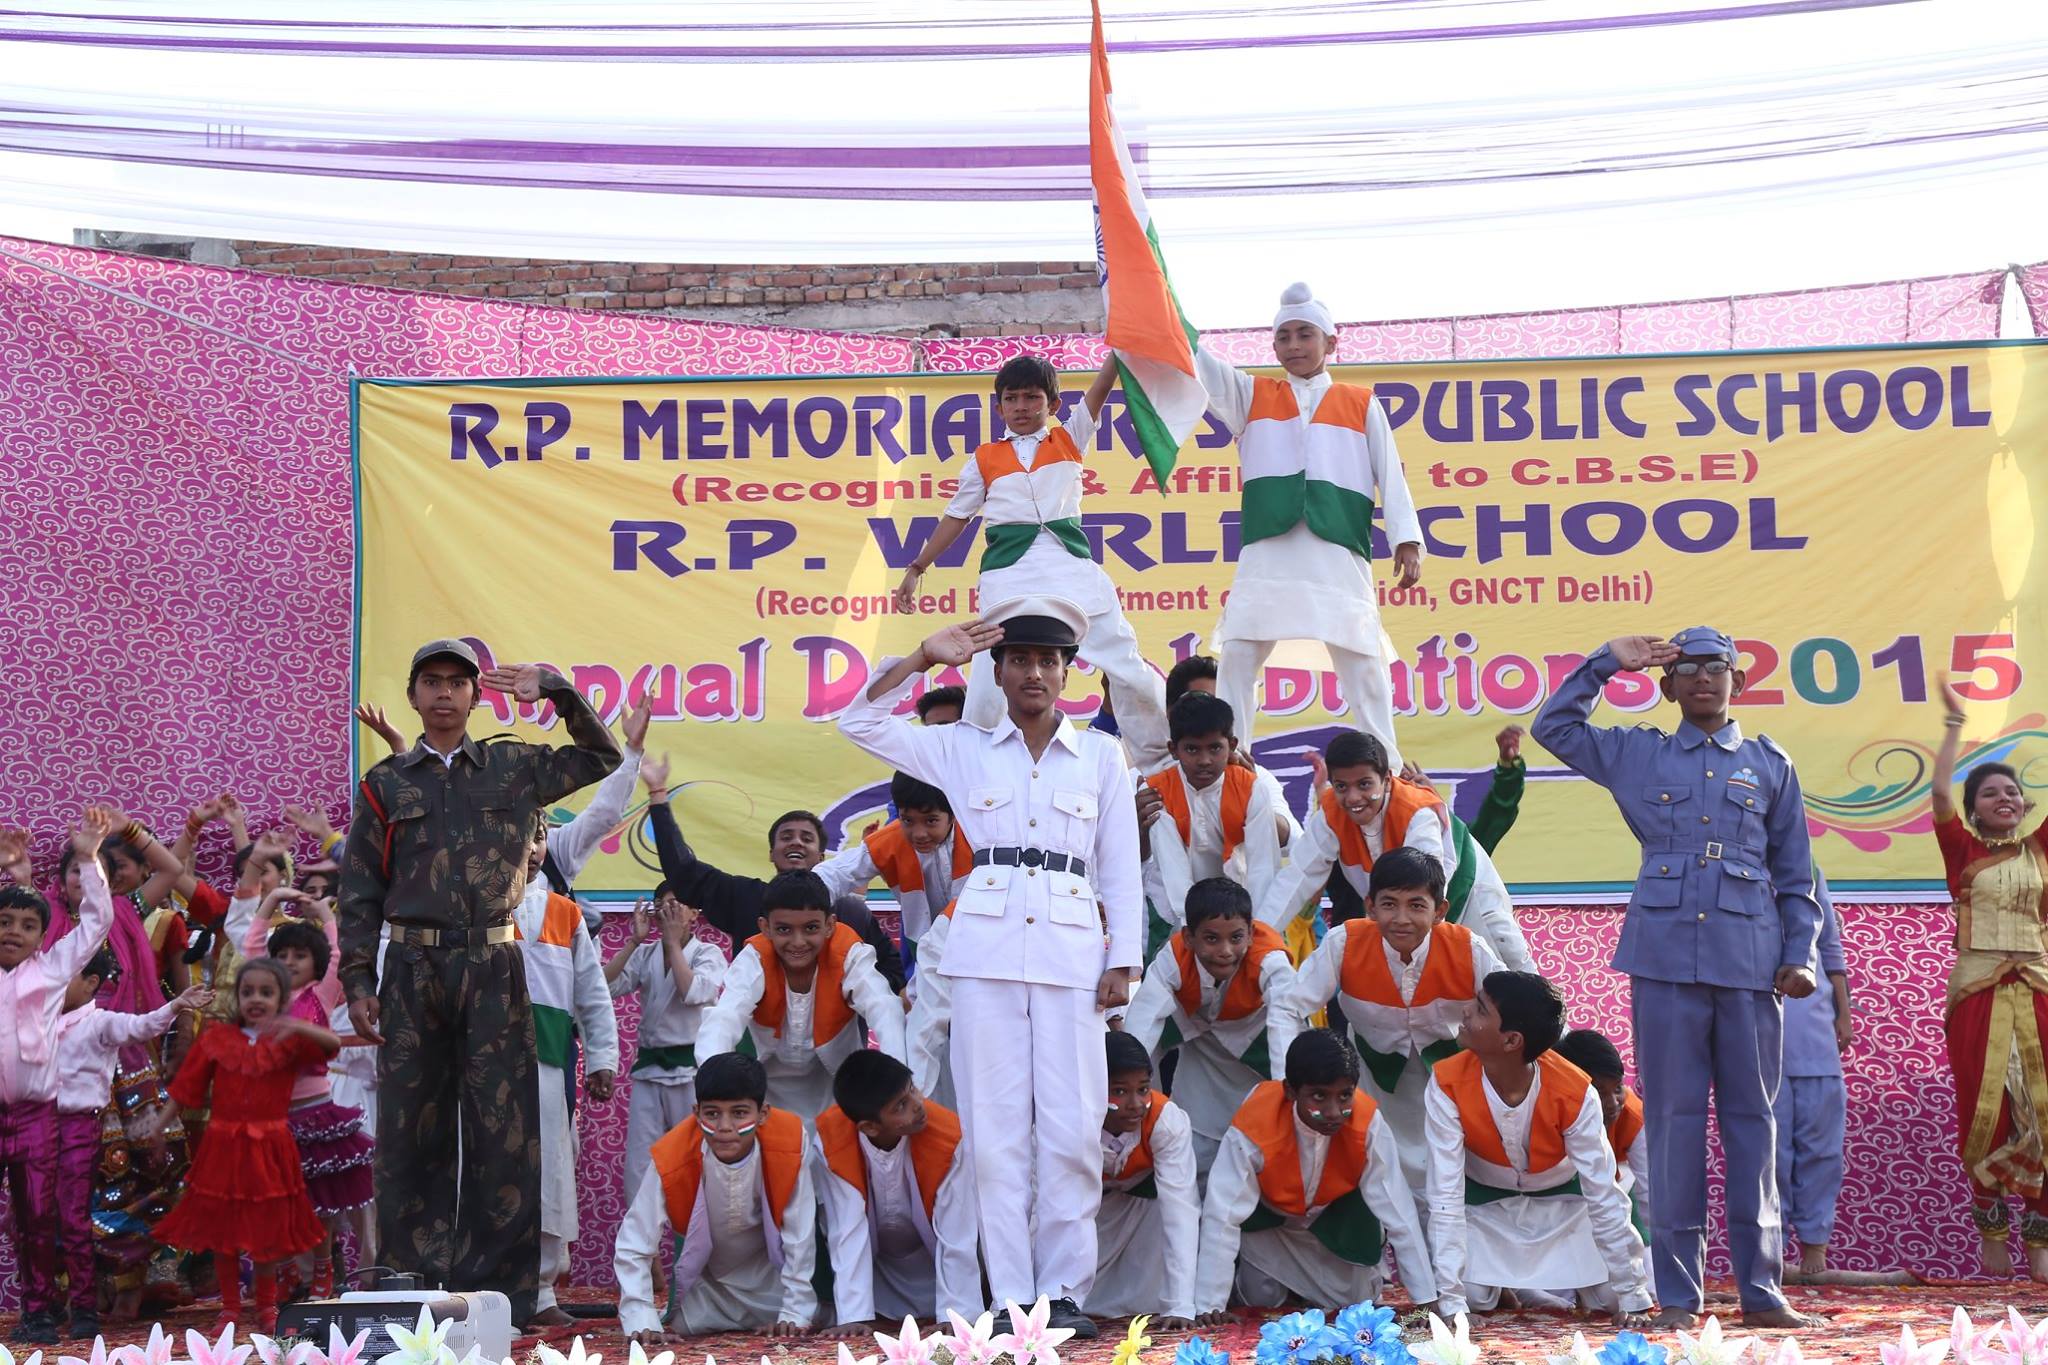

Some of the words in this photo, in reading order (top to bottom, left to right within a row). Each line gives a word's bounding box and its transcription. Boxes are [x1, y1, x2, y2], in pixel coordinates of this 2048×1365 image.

[448, 402, 591, 469] R.P.
[1374, 376, 1647, 443] PUBLIC
[1674, 366, 1992, 443] SCHOOL
[673, 472, 959, 507] (Recognis
[1082, 468, 1108, 496] &
[1428, 461, 1489, 488] to
[1511, 449, 1759, 486] C.B.S.E)
[609, 519, 826, 578] R.P.
[1450, 578, 1545, 605] GNCT
[1558, 572, 1653, 605] Delhi)
[1730, 634, 2022, 705] 2015
